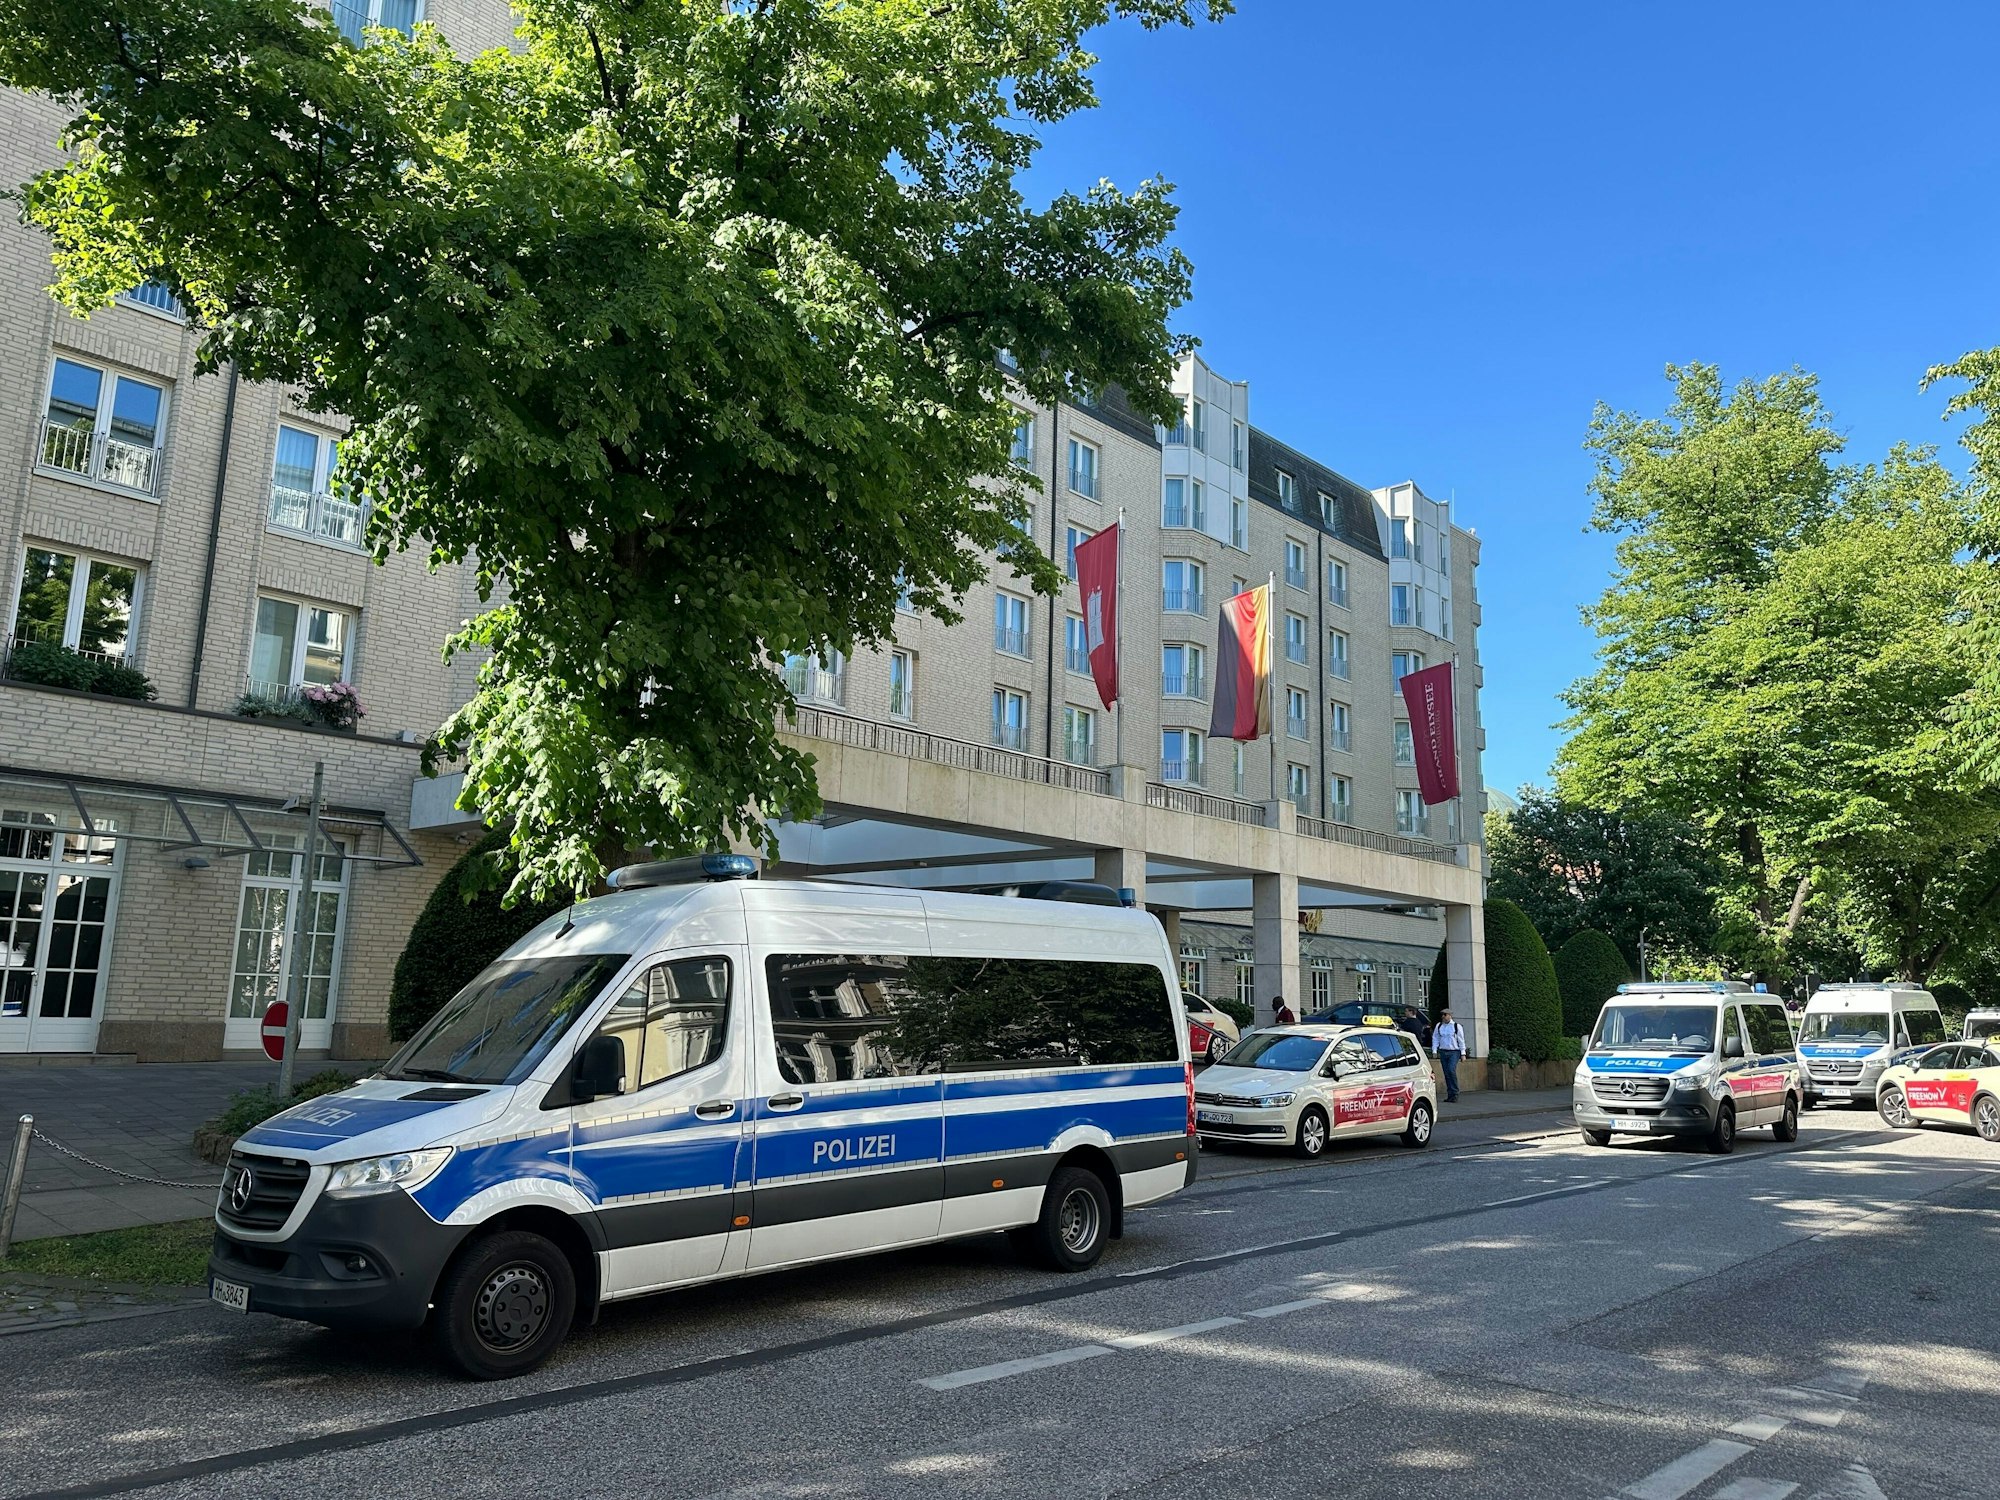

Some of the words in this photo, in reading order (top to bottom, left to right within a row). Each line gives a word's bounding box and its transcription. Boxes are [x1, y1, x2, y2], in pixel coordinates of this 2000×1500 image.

[1425, 682, 1436, 736] ELYSEE
[1604, 1059, 1663, 1067] POLIZEI
[1340, 1098, 1376, 1113] FREENOW
[1908, 1092, 1939, 1101] FREENOW
[813, 1134, 896, 1164] POLIZEI
[225, 1284, 244, 1306] 3843
